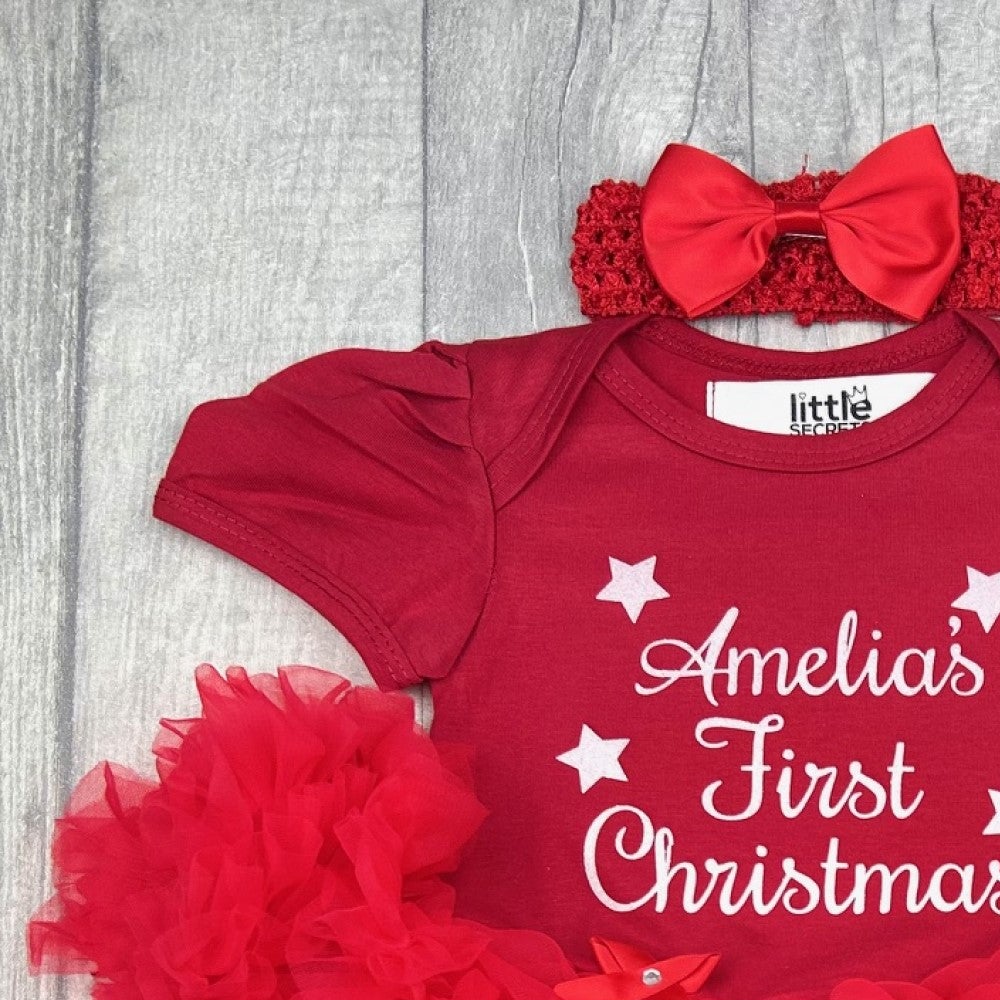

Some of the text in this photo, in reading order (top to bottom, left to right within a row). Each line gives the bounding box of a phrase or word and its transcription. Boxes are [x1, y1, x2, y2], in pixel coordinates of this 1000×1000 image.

[790, 390, 872, 423] little
[790, 422, 869, 436] SECRET
[635, 607, 985, 707] Amelia's
[695, 714, 925, 820] First
